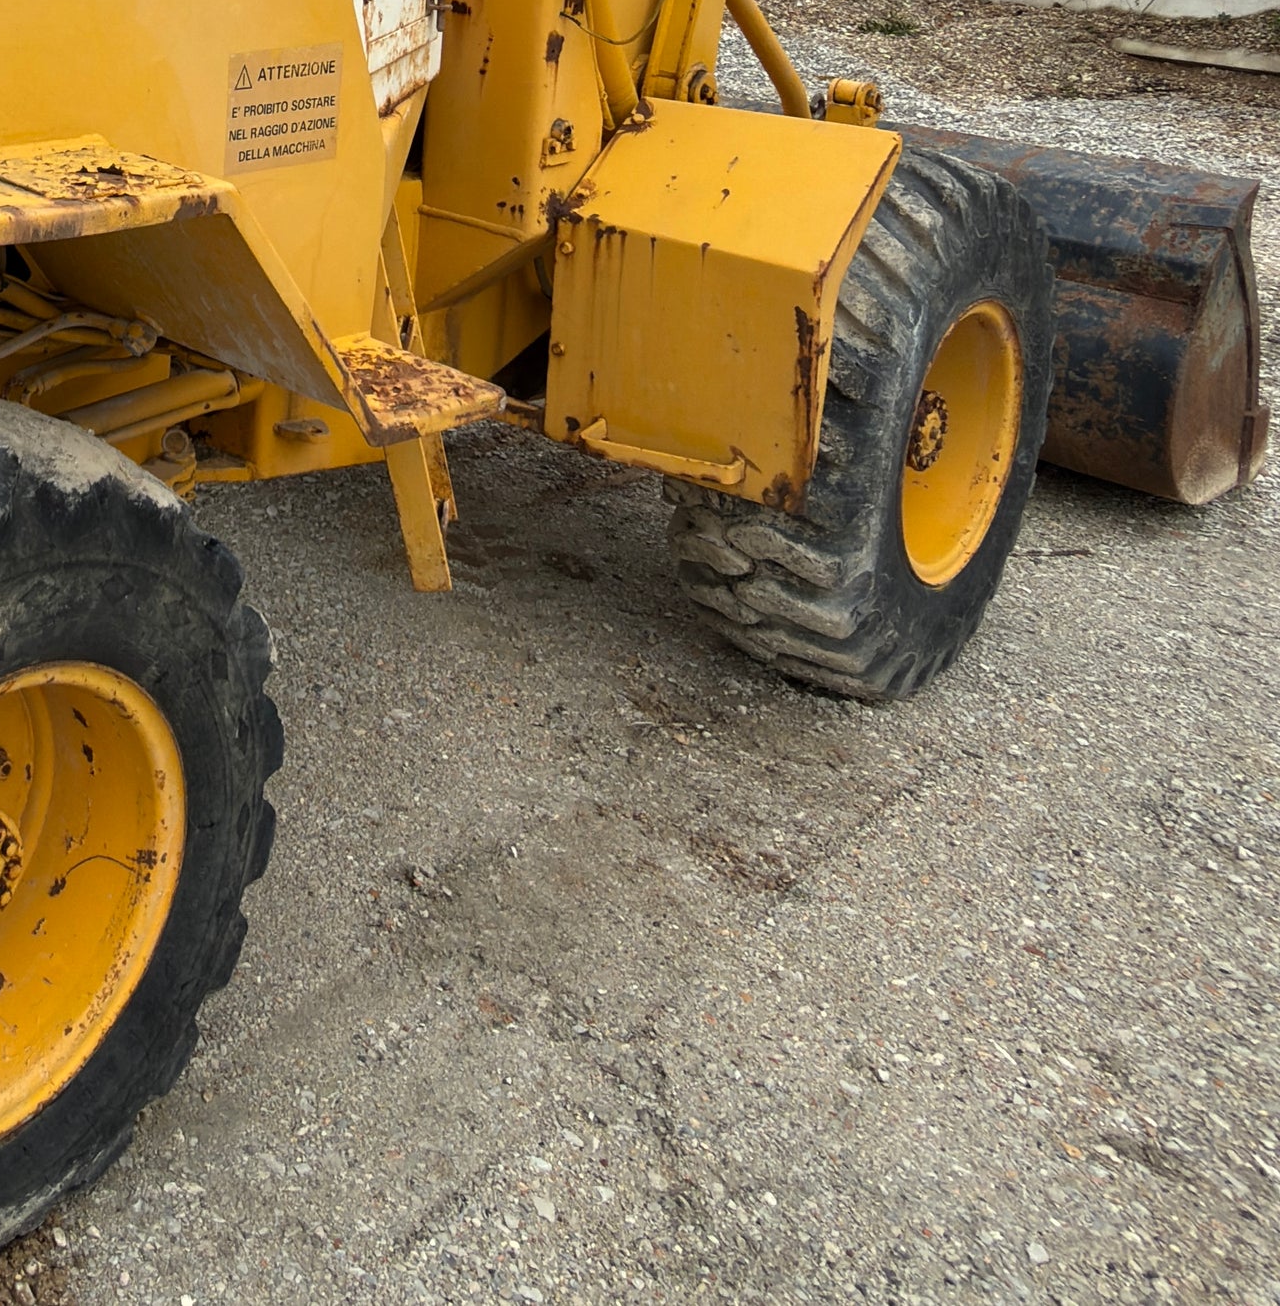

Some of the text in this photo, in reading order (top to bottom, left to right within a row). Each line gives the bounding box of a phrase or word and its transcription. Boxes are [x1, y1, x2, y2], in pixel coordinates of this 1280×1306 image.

[258, 60, 336, 82] ATTENZIONE
[232, 95, 336, 118] E' PROIBITO SOSTARE
[229, 117, 336, 142] NEL RAGGIO D'AZIONE
[238, 139, 325, 162] DELLA MACCHINA
